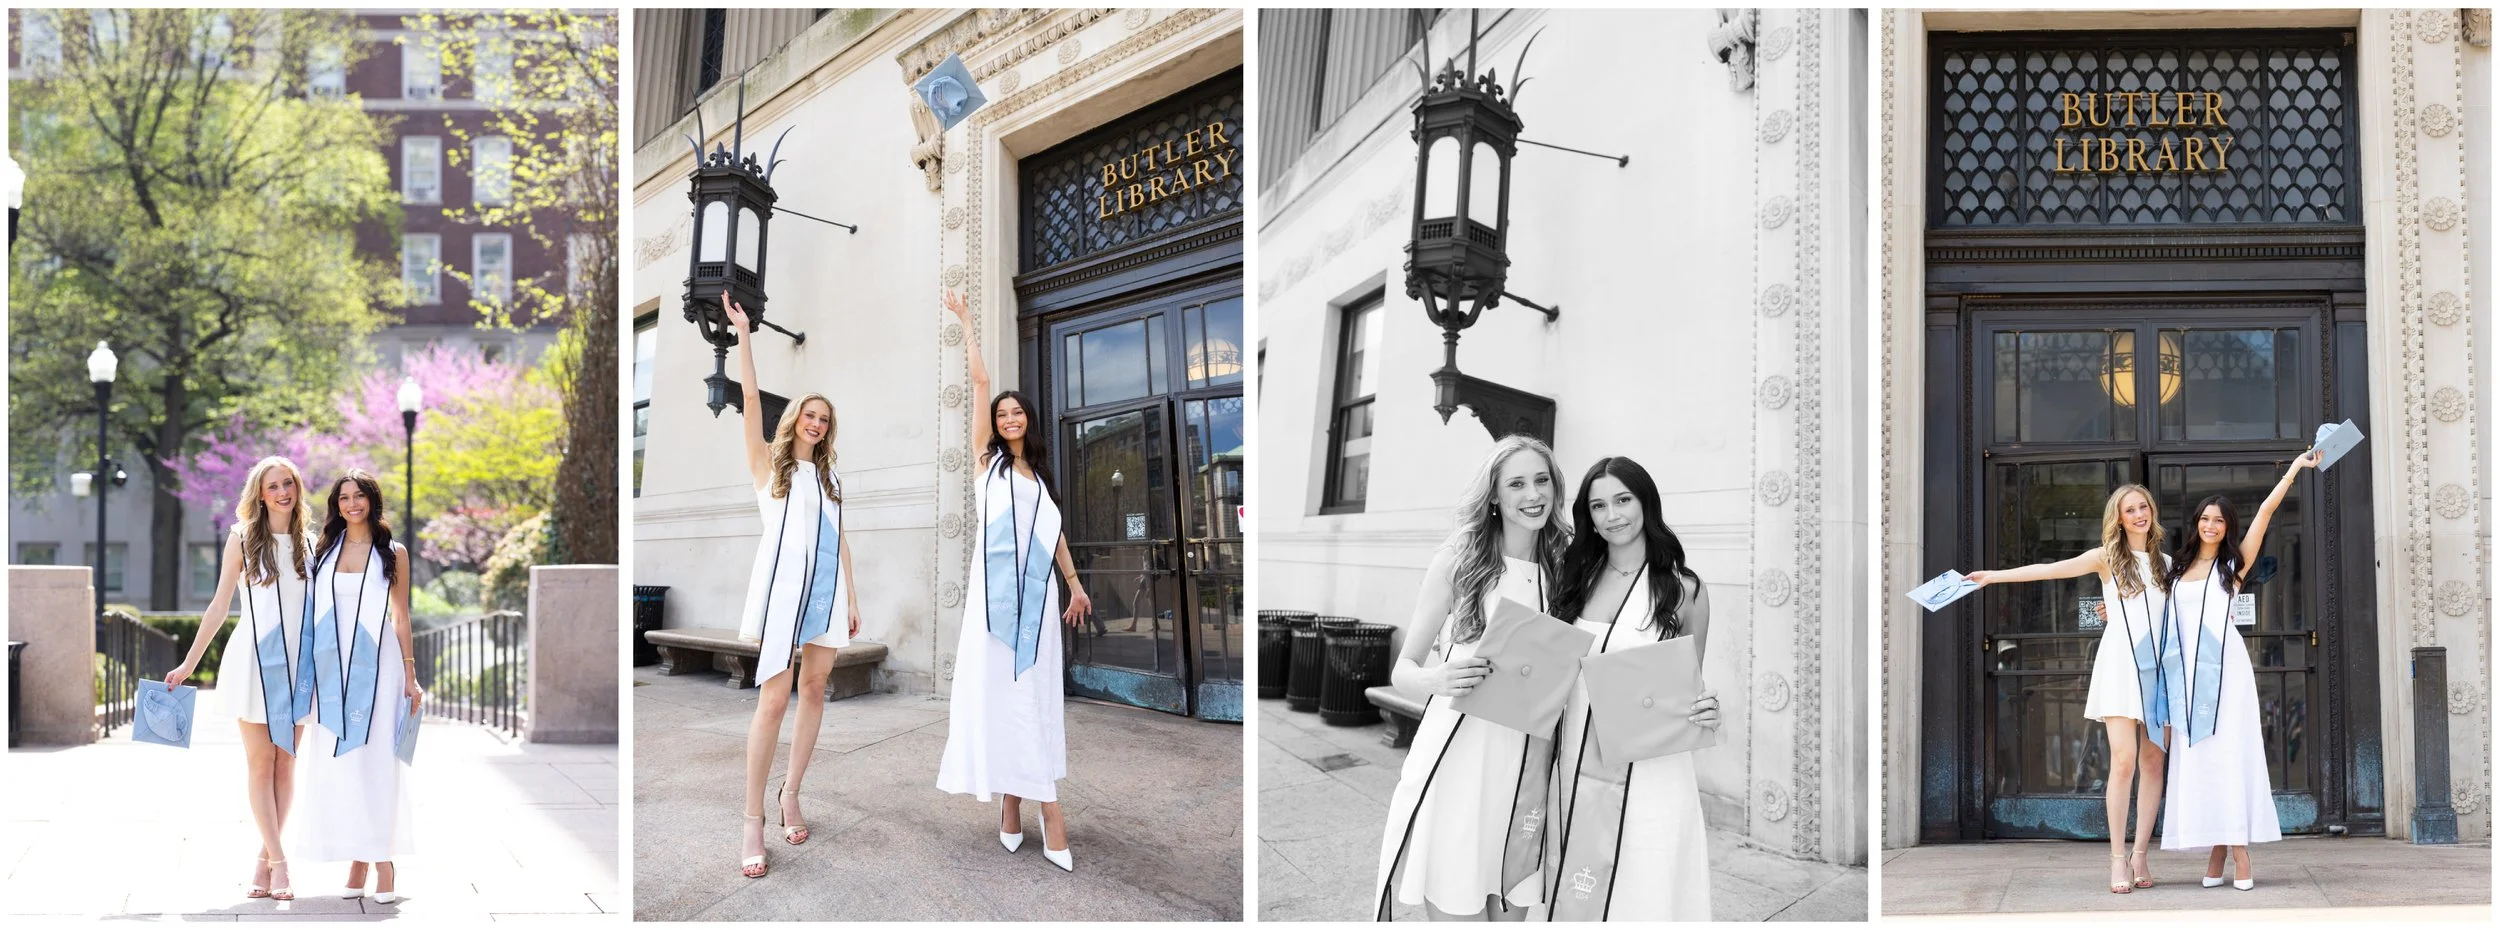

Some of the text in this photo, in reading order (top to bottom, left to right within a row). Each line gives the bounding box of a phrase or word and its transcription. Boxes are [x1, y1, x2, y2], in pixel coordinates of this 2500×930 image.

[2061, 92, 2229, 127] BUTLER
[1102, 121, 1230, 189] BUTLER
[2054, 136, 2234, 173] LIBRARY
[1098, 148, 1236, 220] LIBRARY
[2237, 595, 2250, 603] AED
